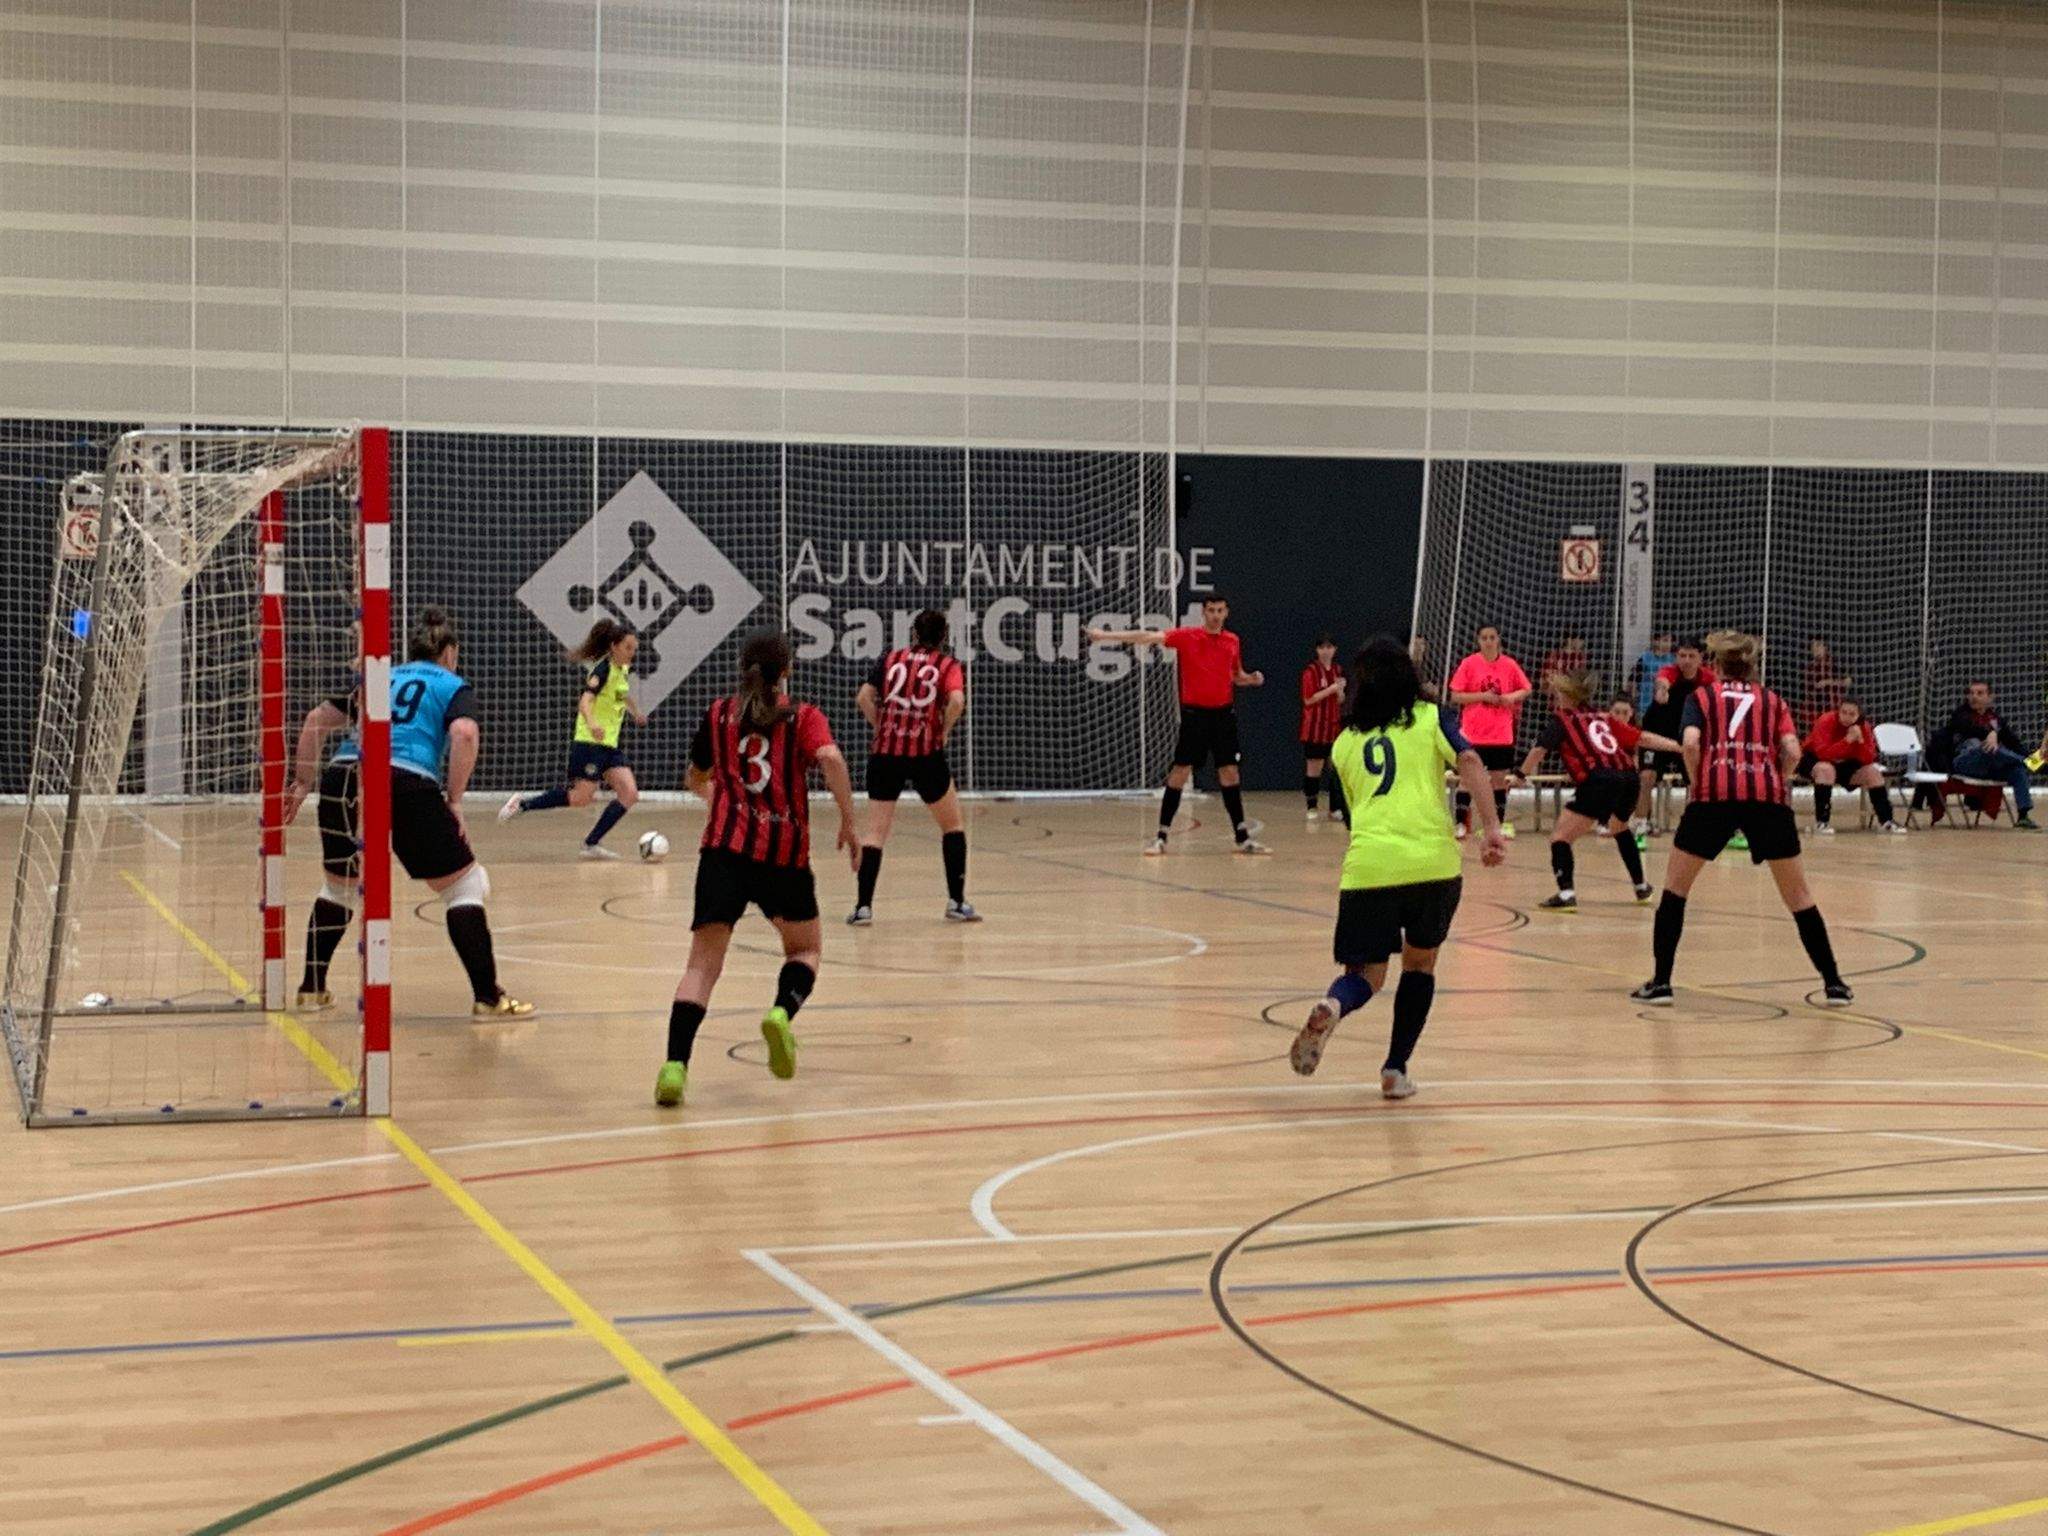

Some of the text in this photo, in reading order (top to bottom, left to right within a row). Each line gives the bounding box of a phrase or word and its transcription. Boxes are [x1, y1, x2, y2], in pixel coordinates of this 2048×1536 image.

[1629, 480, 1650, 515] 3
[1627, 519, 1650, 554] 4
[790, 539, 1215, 593] AJUNTAMENT DE
[390, 678, 427, 725] 9
[884, 662, 941, 709] 23
[1587, 719, 1619, 755] 6
[1720, 690, 1756, 739] 7
[737, 733, 772, 794] 3
[1362, 736, 1397, 798] 9
